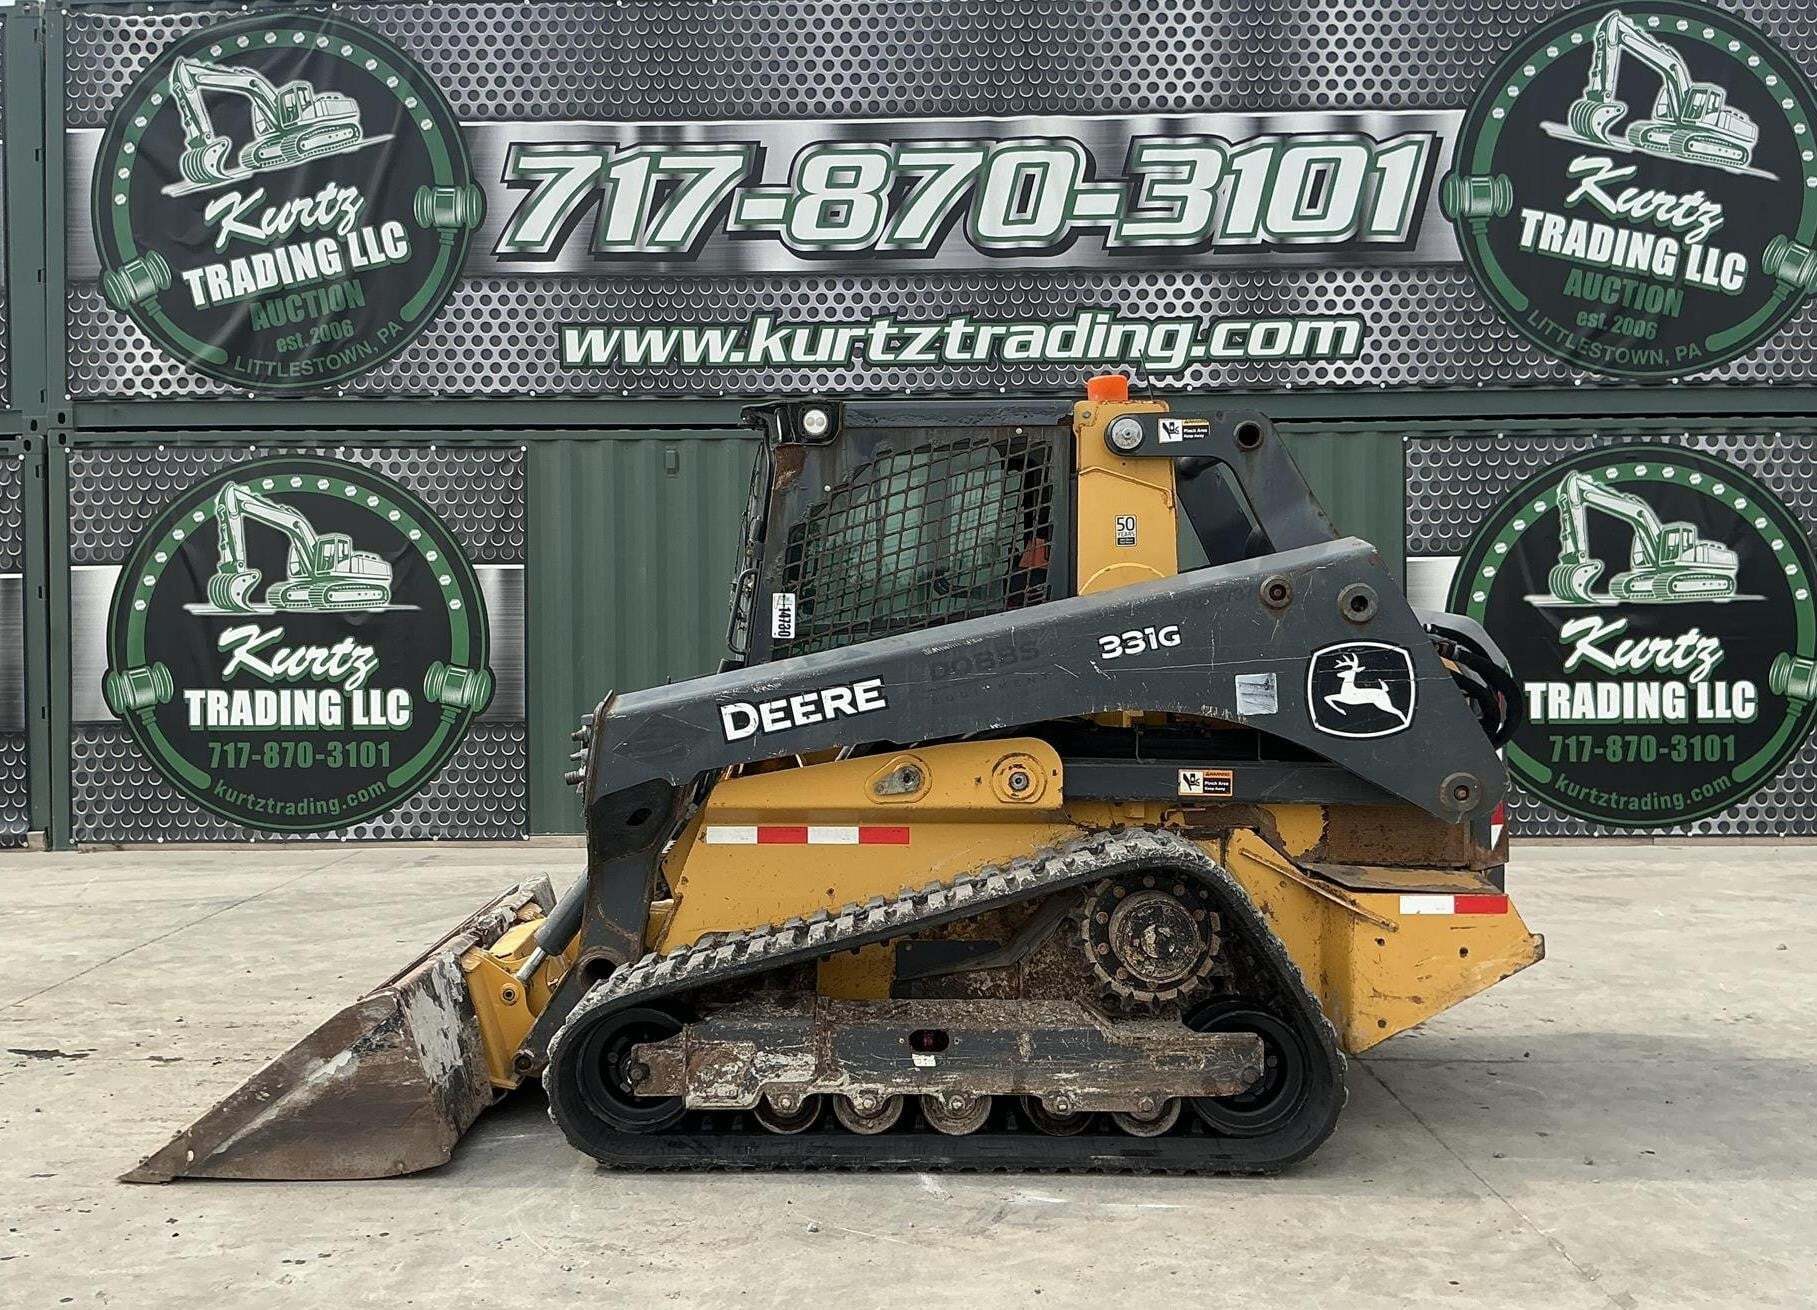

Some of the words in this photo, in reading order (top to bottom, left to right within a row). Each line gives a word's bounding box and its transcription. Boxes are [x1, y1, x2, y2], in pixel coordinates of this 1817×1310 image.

[204, 182, 364, 249] Kurtz
[497, 137, 1431, 258] 717-870-3101
[1564, 155, 1723, 244] Kurtz
[183, 237, 343, 307] TRADING
[347, 221, 409, 268] LLC
[1520, 208, 1680, 277] TRADING
[1685, 244, 1749, 292] LLC
[251, 279, 366, 331] AUCTION
[1563, 269, 1684, 318] AUCTION
[234, 346, 380, 377] LITTLESTOWN,
[376, 321, 404, 348] PA
[276, 331, 309, 353] est.
[310, 319, 354, 347] 2006
[560, 313, 1364, 373] www.kurtztrading.com
[1527, 309, 1669, 367] LITTLESTOWN,
[1676, 341, 1702, 361] PA
[1611, 314, 1658, 341] 2006
[1117, 516, 1135, 531] 50
[219, 625, 377, 690] Kurtz
[1098, 624, 1182, 660] 331G
[1561, 616, 1724, 684] Kurtz
[184, 689, 343, 727] TRADING
[351, 689, 413, 727] LLC
[720, 678, 887, 743] DEERE
[1524, 681, 1686, 721] TRADING
[1696, 680, 1757, 720] LLC
[208, 741, 391, 769] 717-870-3101
[1549, 735, 1736, 762] 717-870-3101
[213, 780, 387, 816] kurtztrading.com
[1554, 774, 1732, 811] kurtztrading.com
